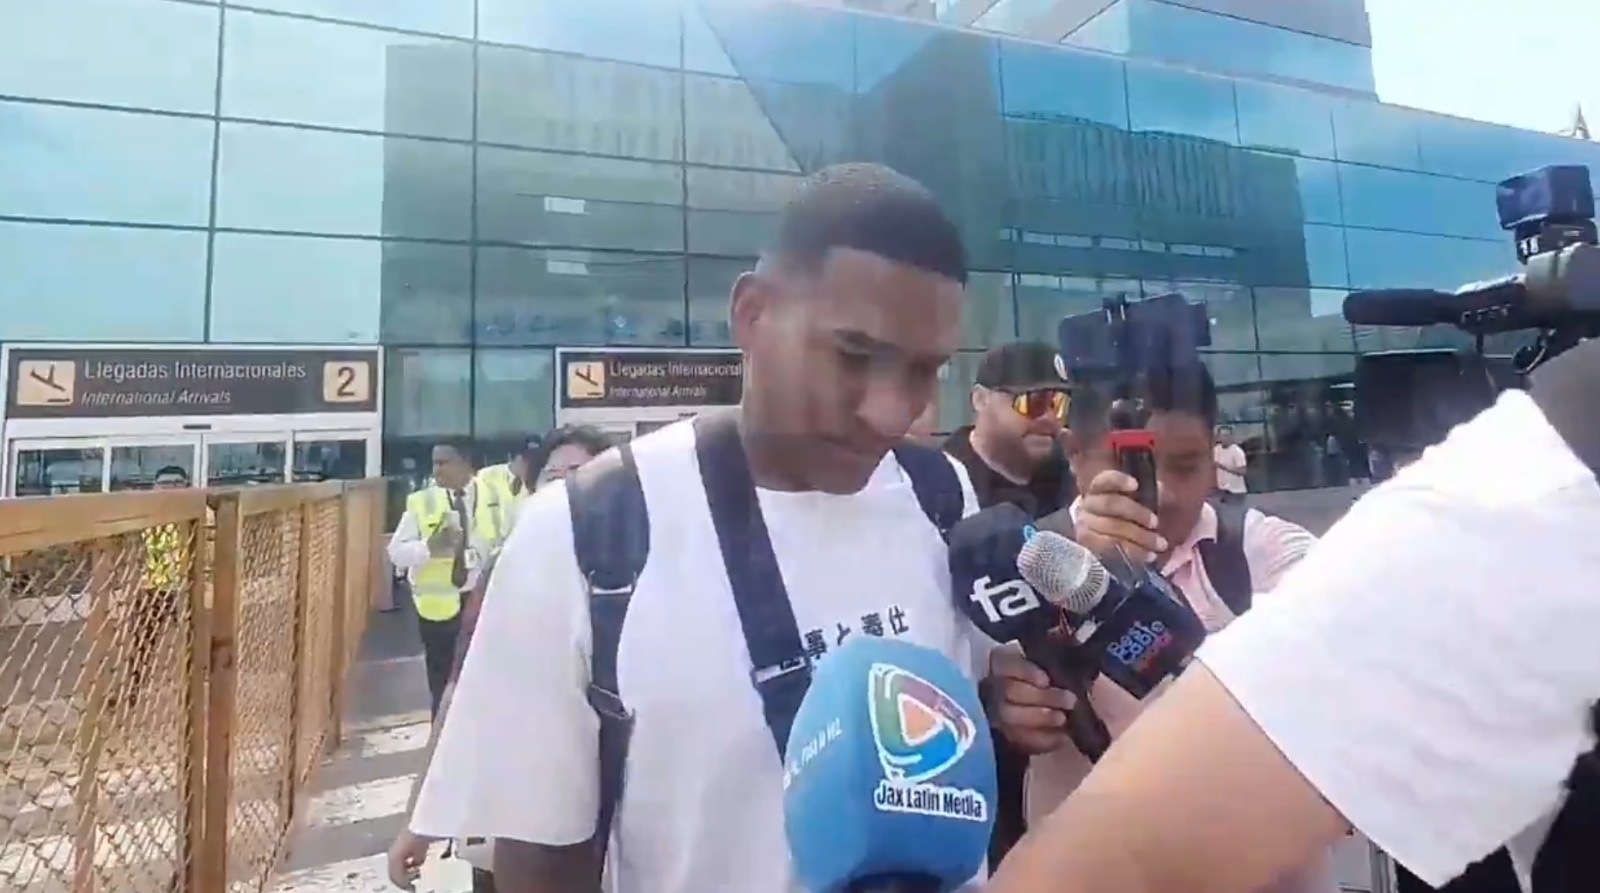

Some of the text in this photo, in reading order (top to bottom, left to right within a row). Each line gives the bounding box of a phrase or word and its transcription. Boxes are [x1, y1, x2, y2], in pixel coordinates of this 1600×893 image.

[85, 360, 307, 382] Llegadas Internacionales
[609, 361, 742, 378] Llegadas Internacional
[336, 366, 355, 397] 2
[81, 389, 231, 405] International Arrivals
[876, 783, 983, 818] Jax Latin Media
